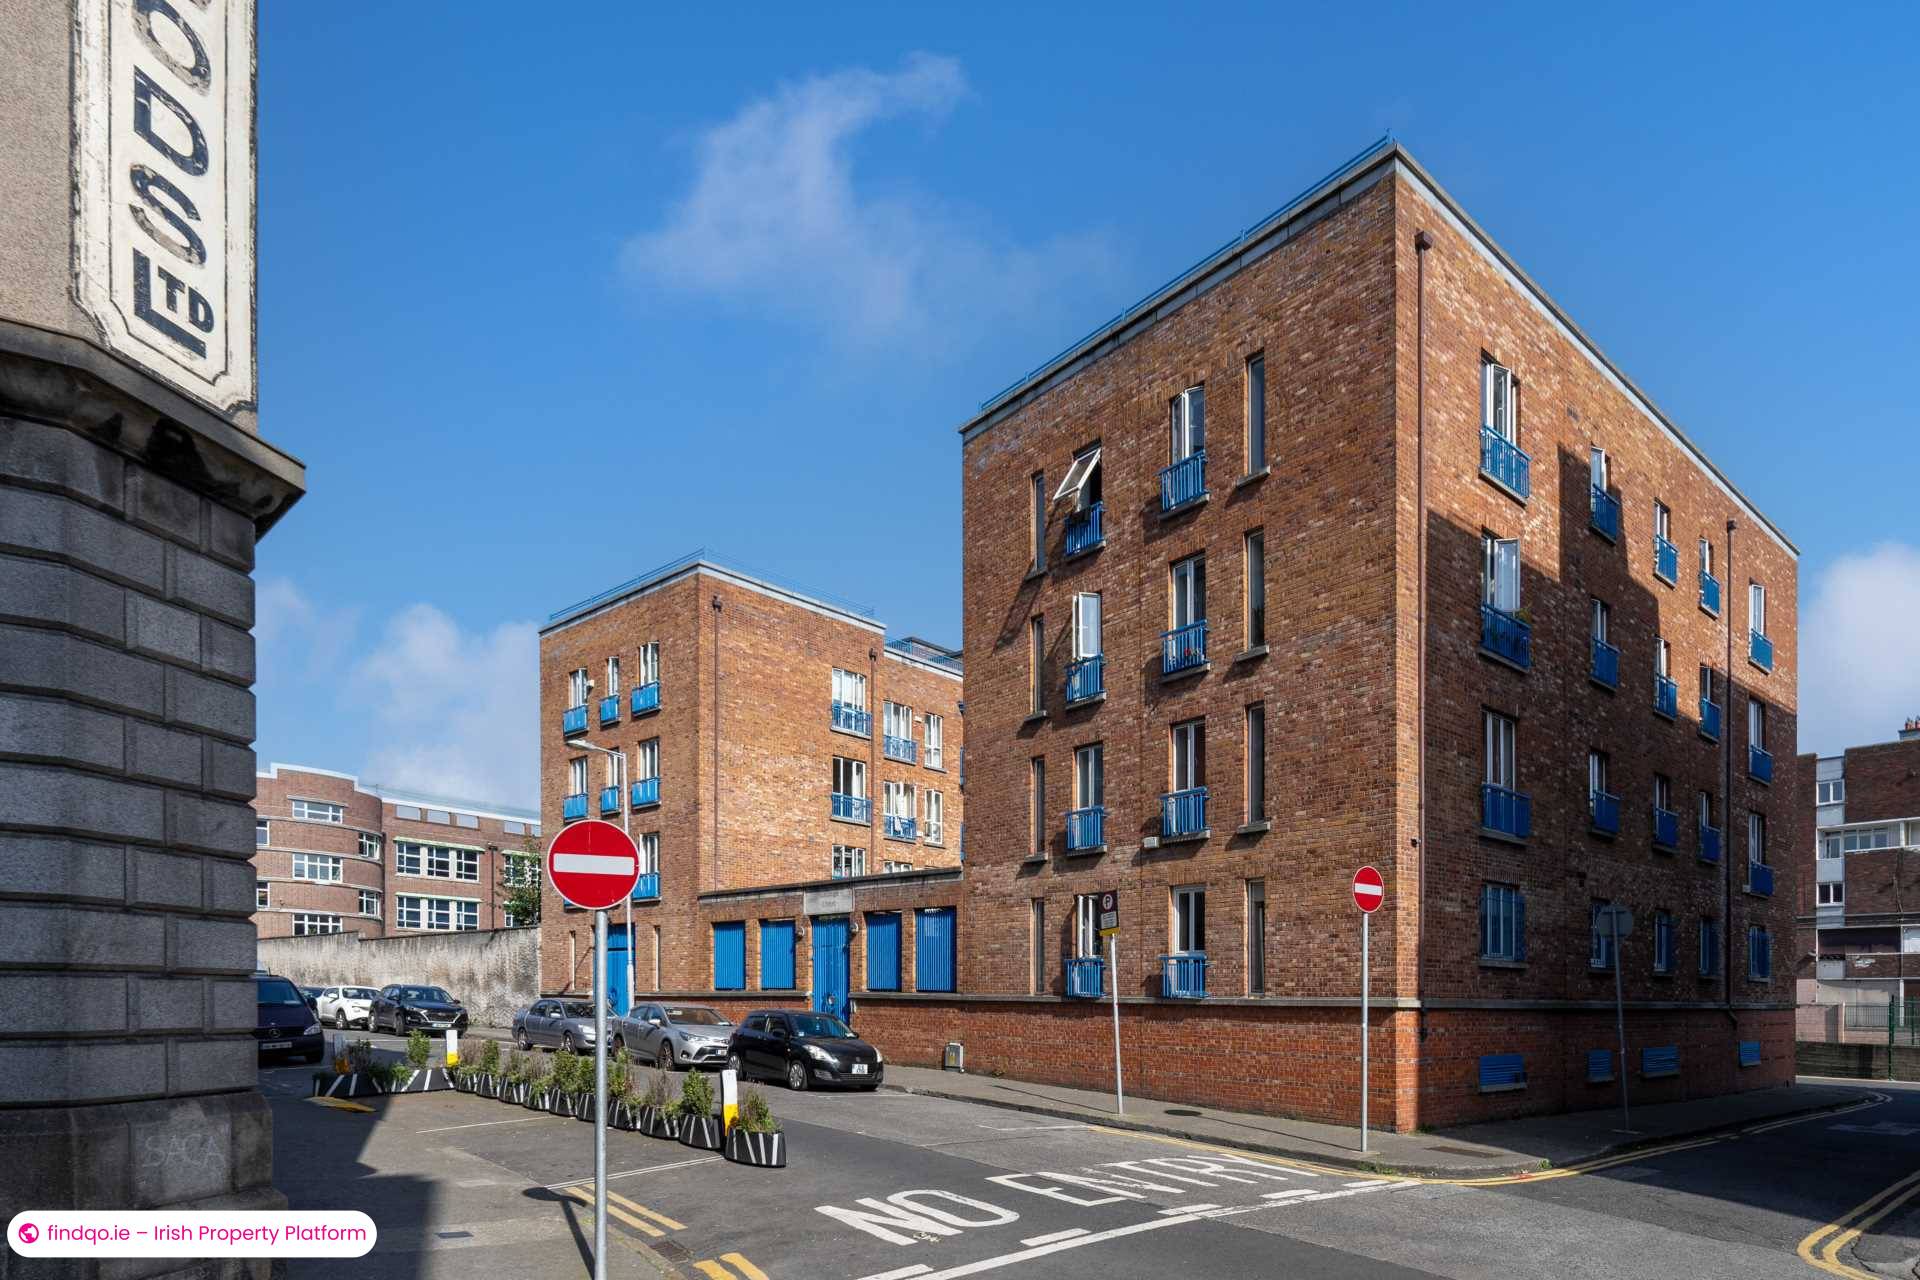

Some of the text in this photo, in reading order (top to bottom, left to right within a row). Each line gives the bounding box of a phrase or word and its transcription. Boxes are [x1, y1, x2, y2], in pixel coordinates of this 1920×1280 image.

[131, 0, 215, 359] ODS LTD
[814, 1153, 1320, 1246] NO ENTRY
